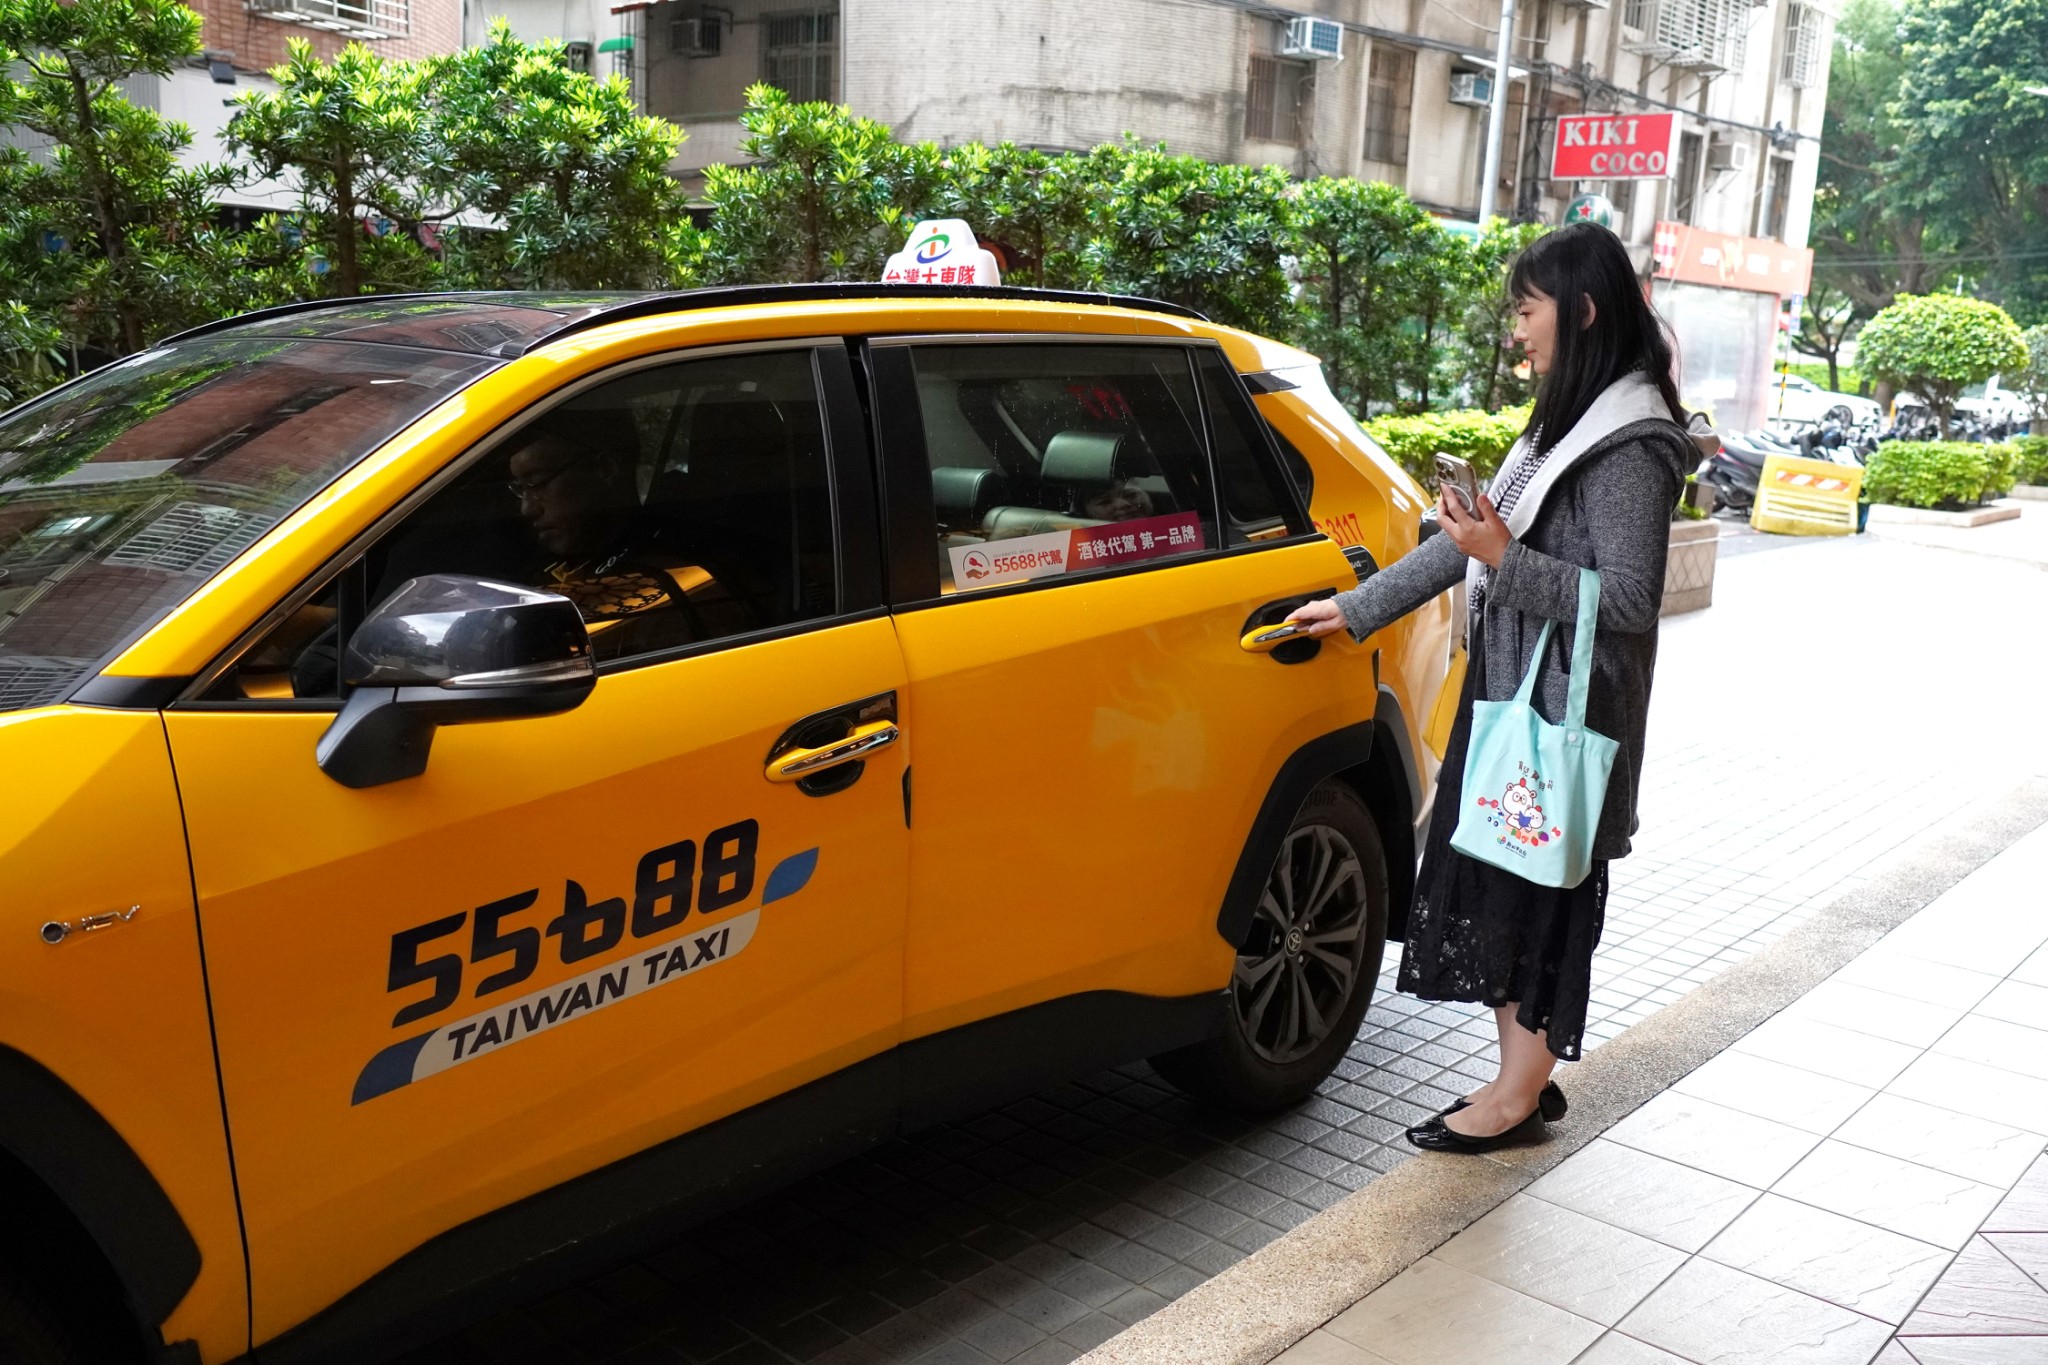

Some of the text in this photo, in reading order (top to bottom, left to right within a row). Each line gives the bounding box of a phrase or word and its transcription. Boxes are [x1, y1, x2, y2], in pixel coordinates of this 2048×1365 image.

[1563, 119, 1638, 146] KIKI
[1590, 151, 1665, 173] COCO
[1076, 525, 1196, 560] 酒後代駕 第一品牌
[994, 549, 1063, 574] 55688代駕
[387, 818, 759, 1028] 55688
[448, 928, 730, 1061] TAIWAN TAXI
